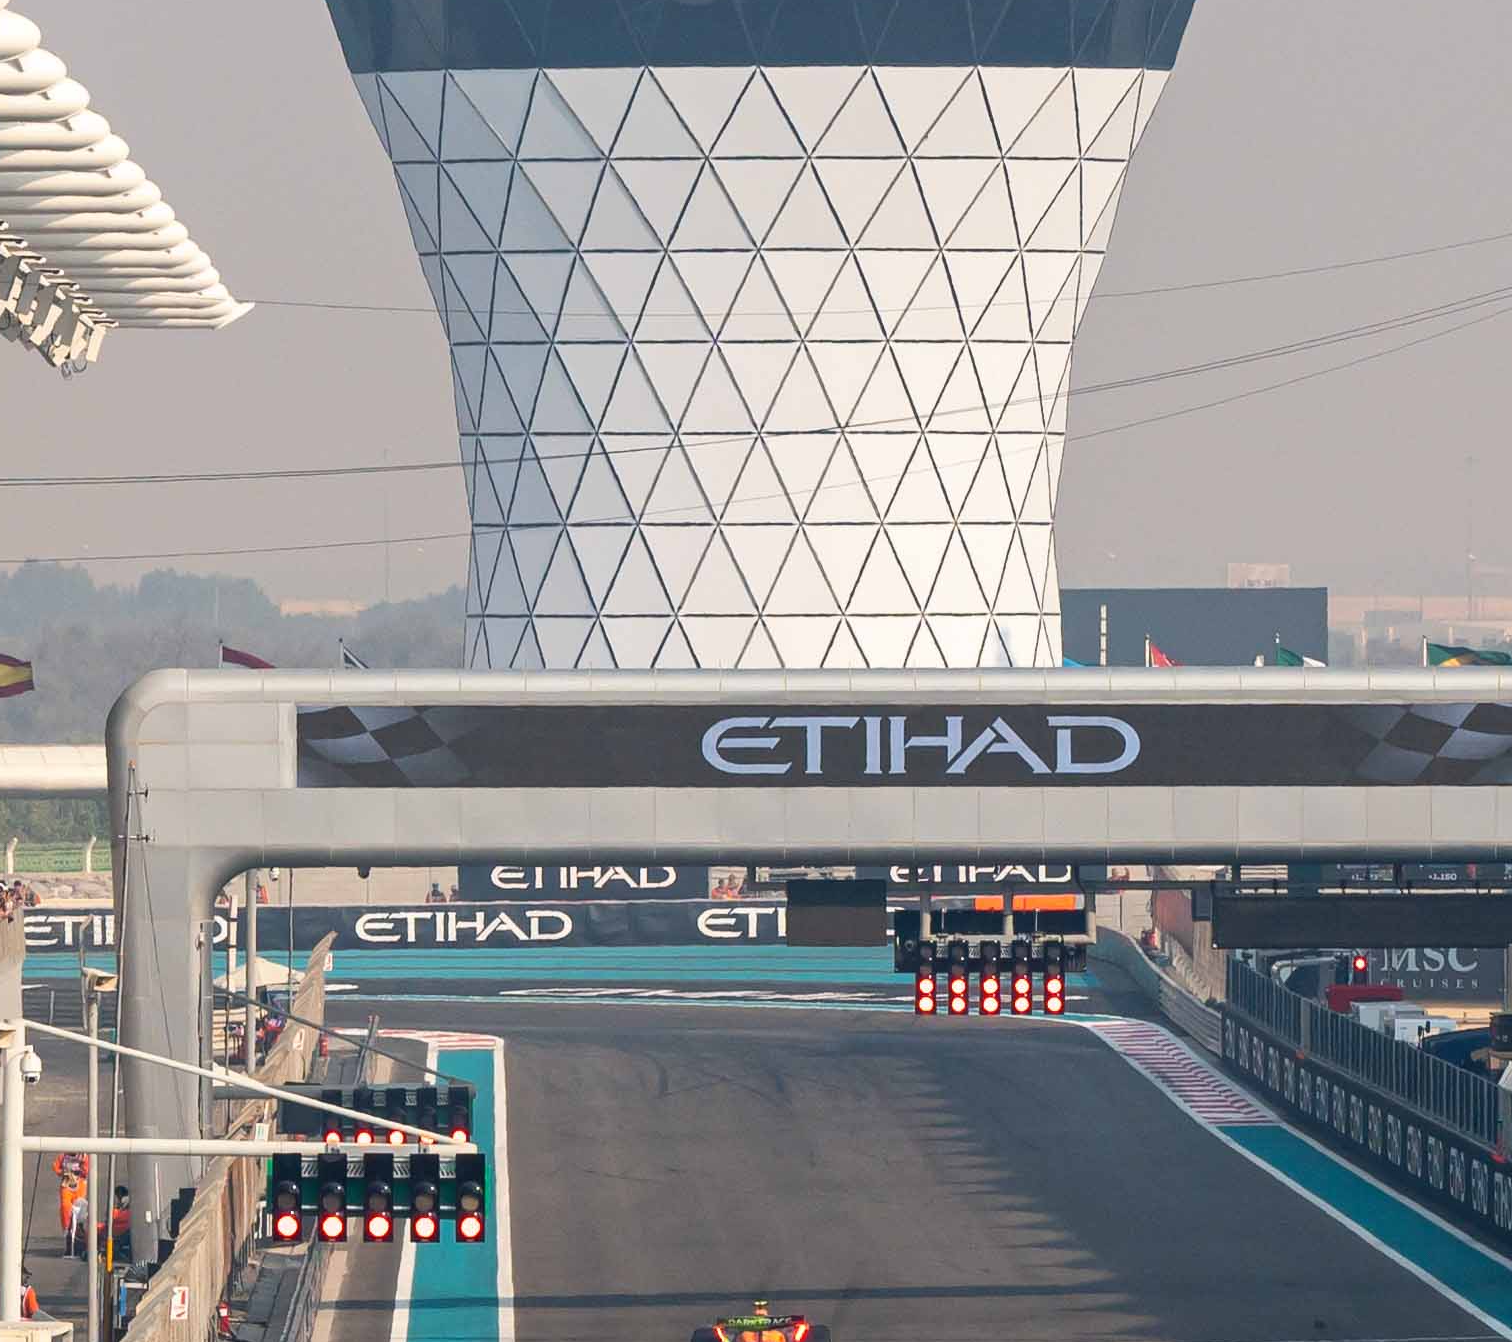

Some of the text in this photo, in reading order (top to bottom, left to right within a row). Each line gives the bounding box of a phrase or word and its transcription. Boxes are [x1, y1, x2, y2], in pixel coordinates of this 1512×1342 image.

[701, 714, 1143, 776] ETIHAD
[355, 909, 573, 942] ETIHAD
[1380, 948, 1479, 972] MSC
